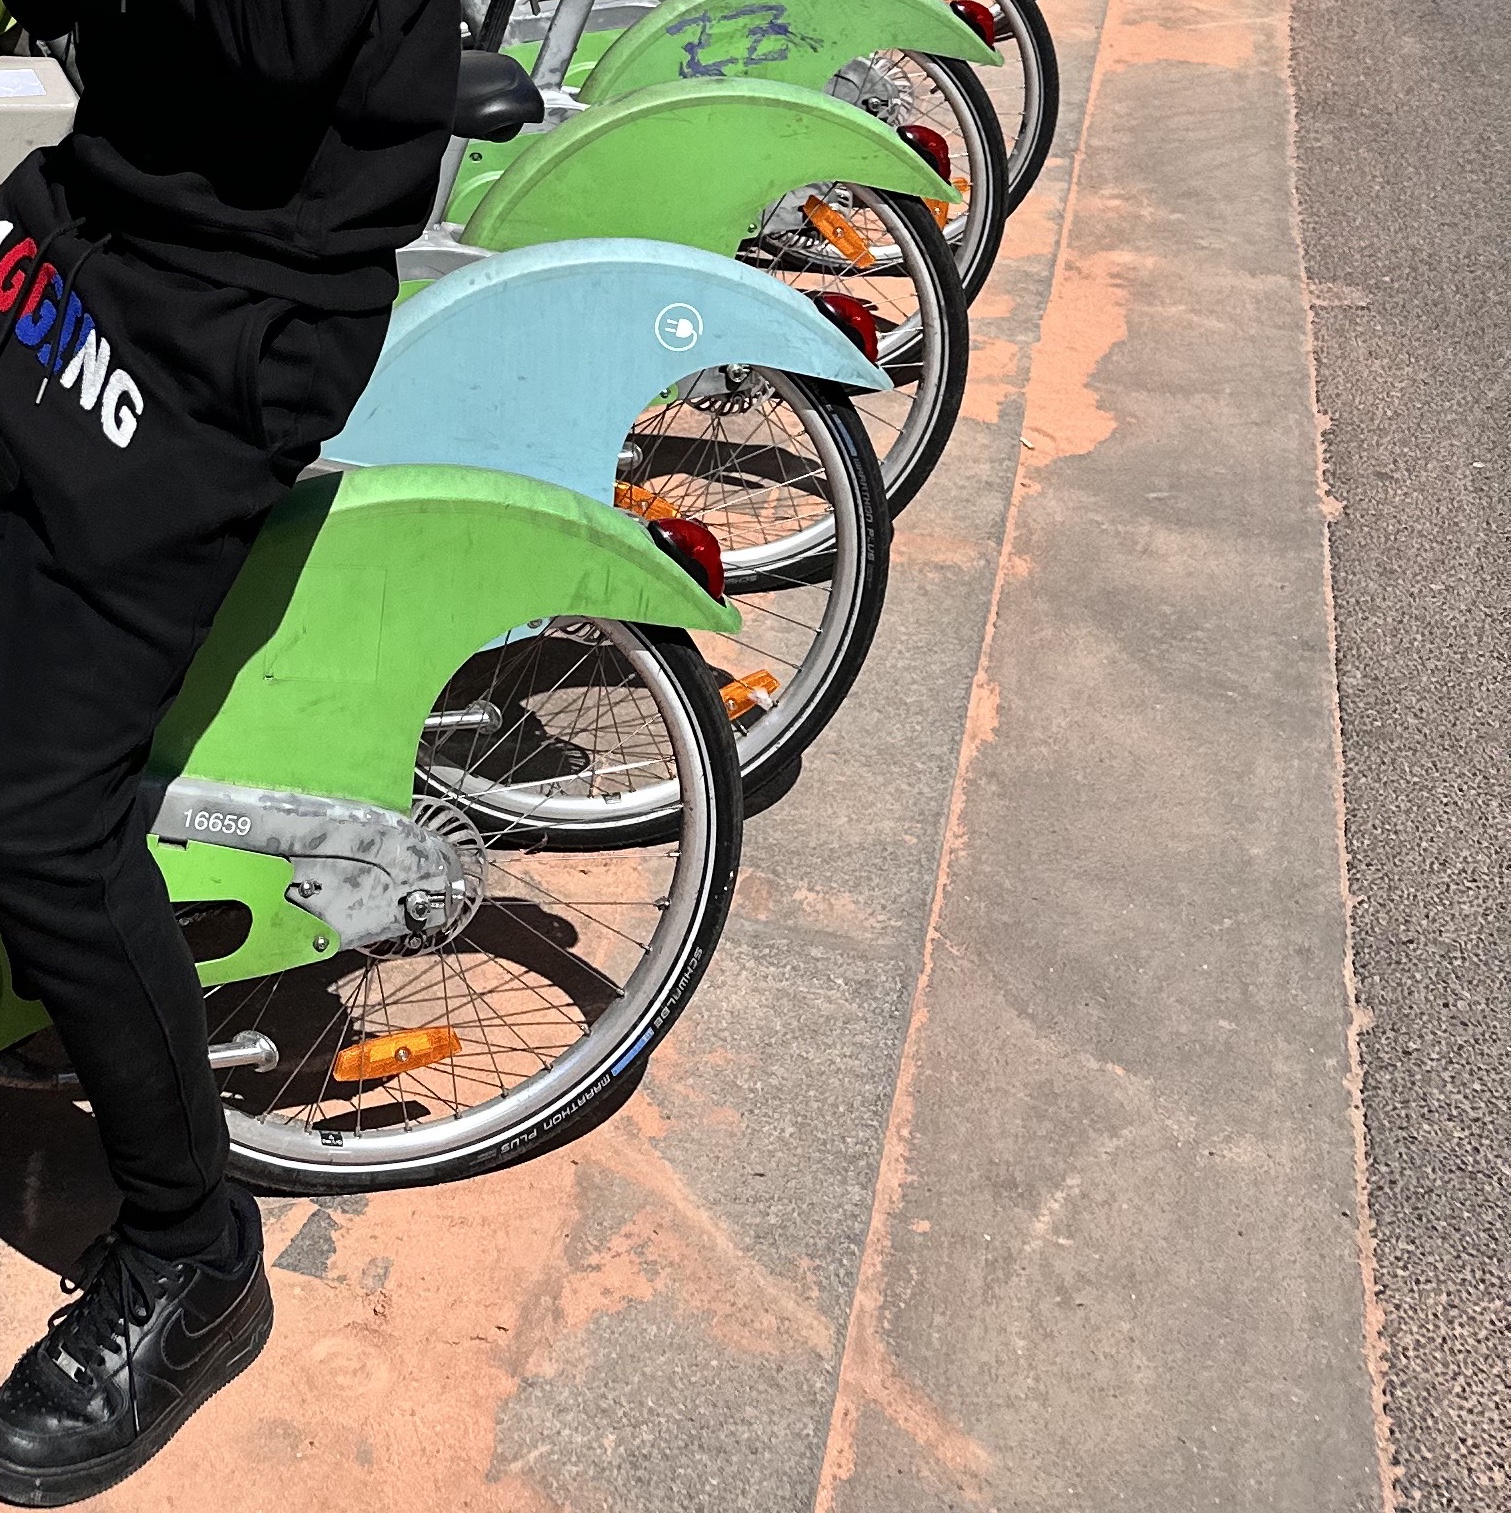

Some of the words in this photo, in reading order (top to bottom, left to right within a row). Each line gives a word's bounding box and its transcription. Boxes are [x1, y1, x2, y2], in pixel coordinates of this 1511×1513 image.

[867, 529, 876, 562] PLUS
[183, 809, 252, 836] 16659
[653, 946, 704, 1029] SCHWALBE
[543, 1074, 611, 1131] MARATHON
[500, 1128, 537, 1154] PLUS
